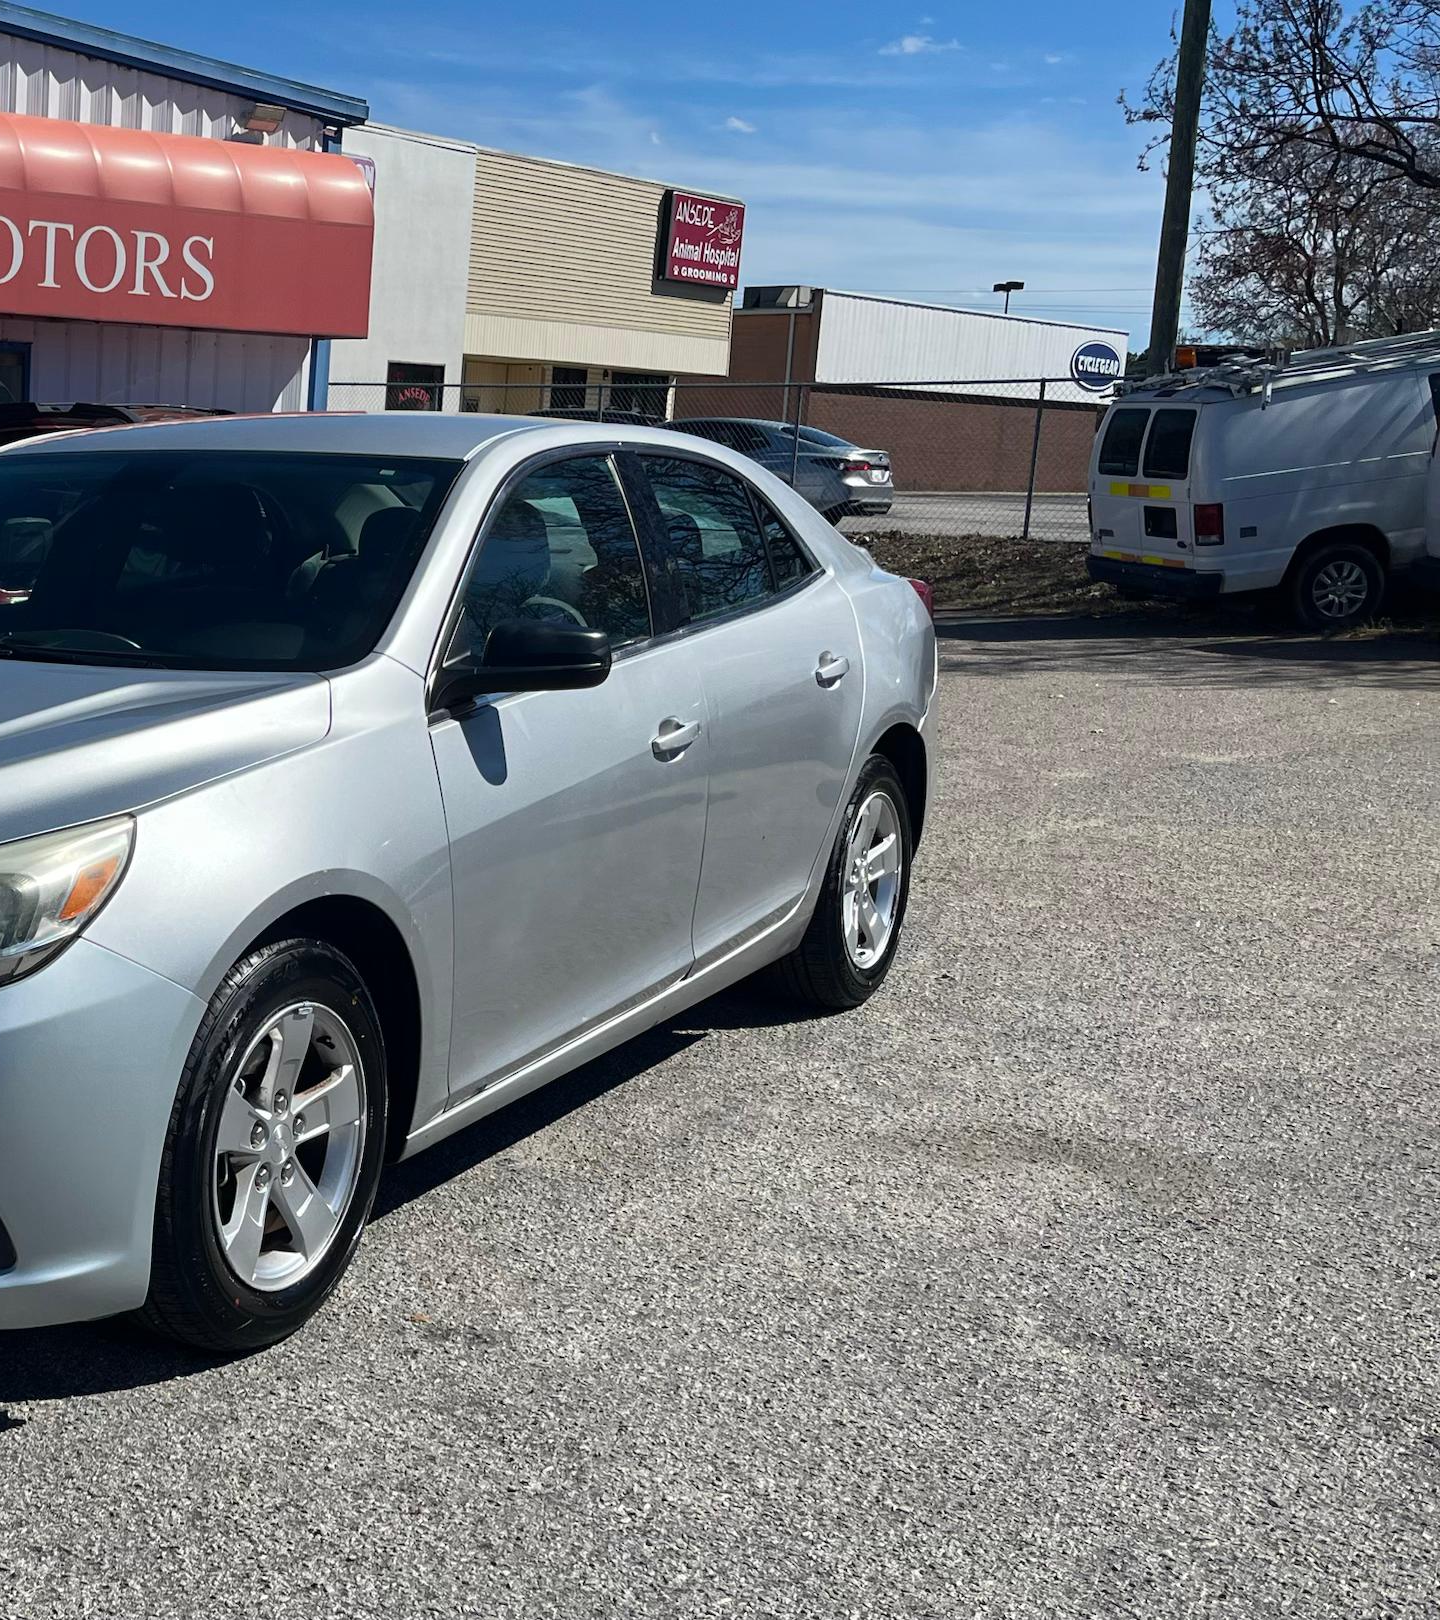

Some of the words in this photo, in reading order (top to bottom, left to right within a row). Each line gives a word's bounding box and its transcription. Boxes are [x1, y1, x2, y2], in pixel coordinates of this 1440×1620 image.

[675, 200, 716, 229] ANSEDE
[672, 237, 703, 262] Animal
[702, 241, 740, 271] Hospital
[680, 266, 728, 284] GROOMING
[398, 387, 431, 403] ANSEDE
